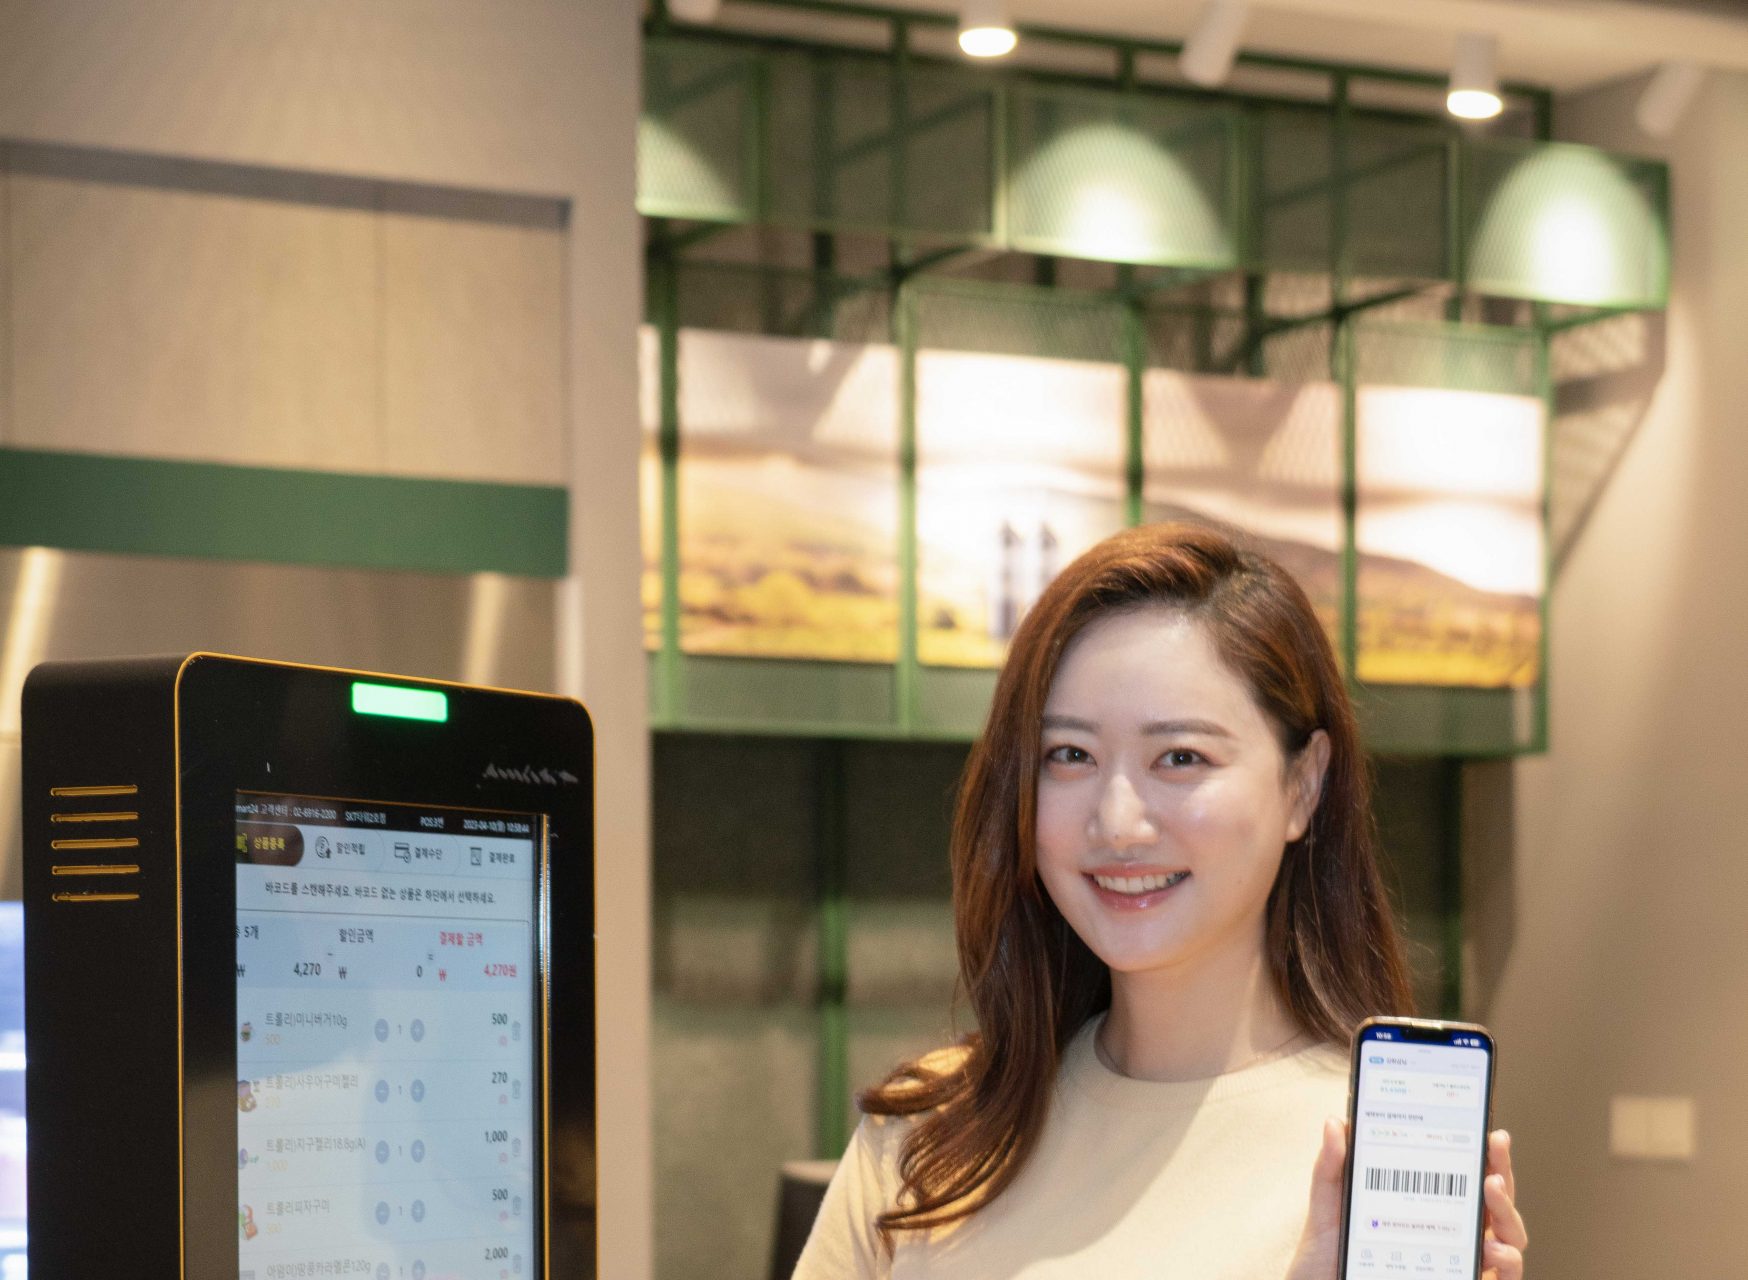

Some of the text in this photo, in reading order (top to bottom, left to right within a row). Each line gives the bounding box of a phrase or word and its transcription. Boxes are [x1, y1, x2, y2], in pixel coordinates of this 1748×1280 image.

[338, 928, 374, 943] 할인금액
[293, 962, 322, 977] 4,270
[491, 1013, 508, 1026] 500
[491, 1071, 508, 1084] 270
[485, 1130, 508, 1143] 1,000
[492, 1188, 508, 1201] 500
[485, 1247, 508, 1261] 2,000
